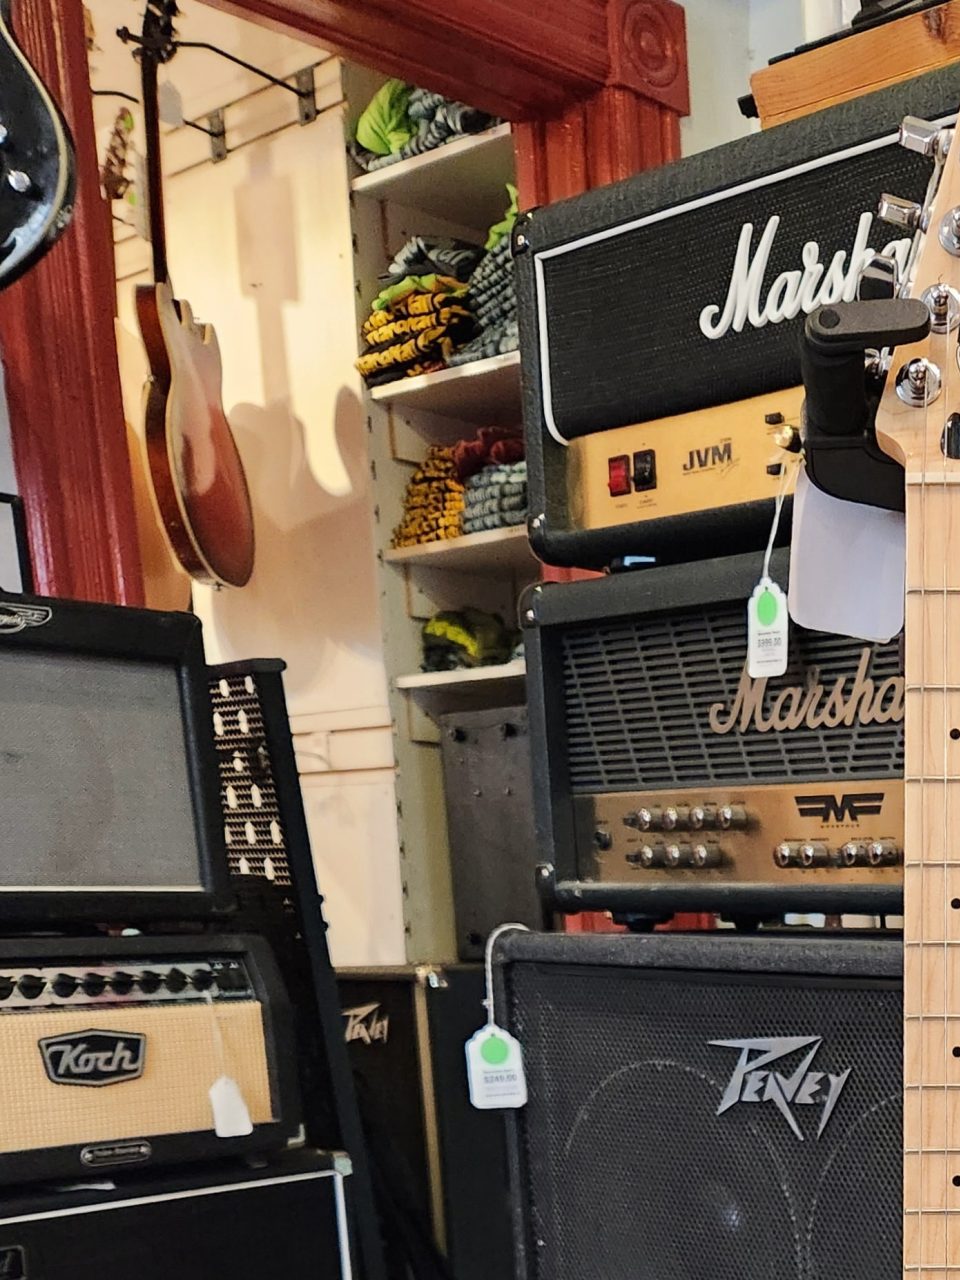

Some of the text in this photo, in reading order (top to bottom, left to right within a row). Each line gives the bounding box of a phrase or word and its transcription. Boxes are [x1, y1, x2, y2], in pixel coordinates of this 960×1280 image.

[682, 442, 733, 472] JVM
[709, 647, 905, 735] Marsha
[48, 1041, 140, 1075] Koch
